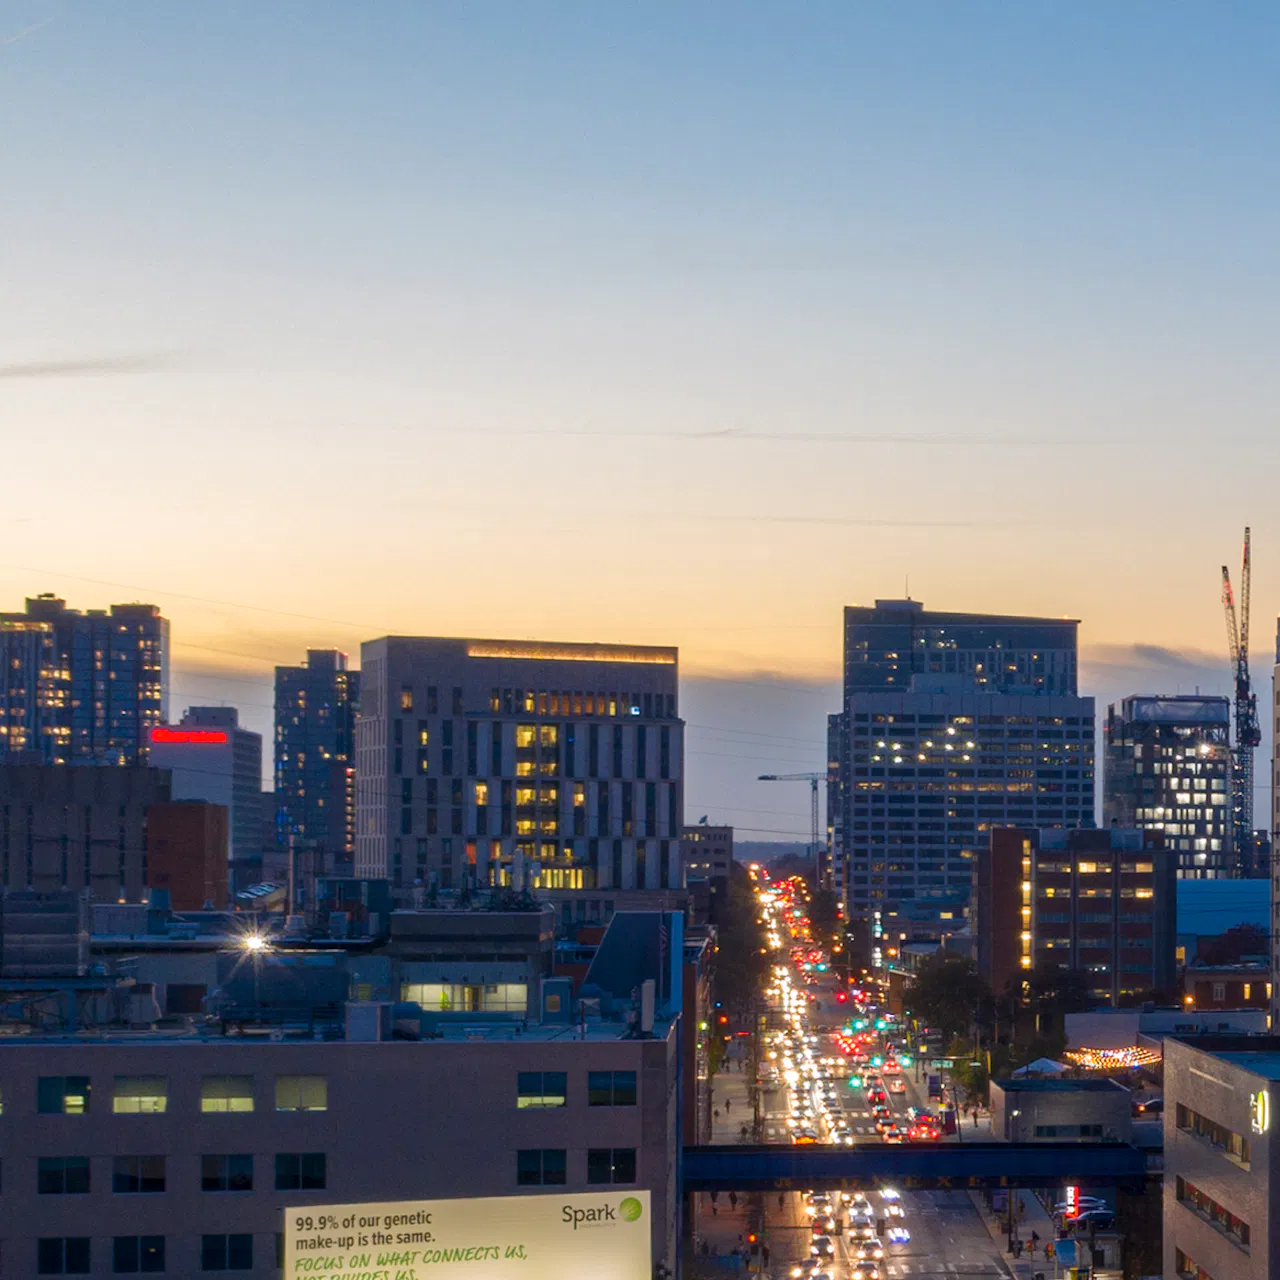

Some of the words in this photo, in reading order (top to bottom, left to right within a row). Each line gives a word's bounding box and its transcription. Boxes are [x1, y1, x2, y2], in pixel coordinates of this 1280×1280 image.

[295, 1215, 339, 1232] 99.9%
[342, 1214, 356, 1229] of
[359, 1216, 380, 1229] our
[384, 1210, 433, 1230] genetic
[562, 1204, 616, 1230] Spark
[295, 1234, 355, 1251] make-up
[358, 1232, 369, 1247] is
[372, 1231, 393, 1246] the
[396, 1231, 436, 1244] same.
[294, 1256, 345, 1272] FOCUS
[350, 1253, 371, 1269] ON
[376, 1251, 421, 1266] WHAT
[422, 1246, 500, 1264] CONNECTS
[504, 1244, 529, 1261] US,
